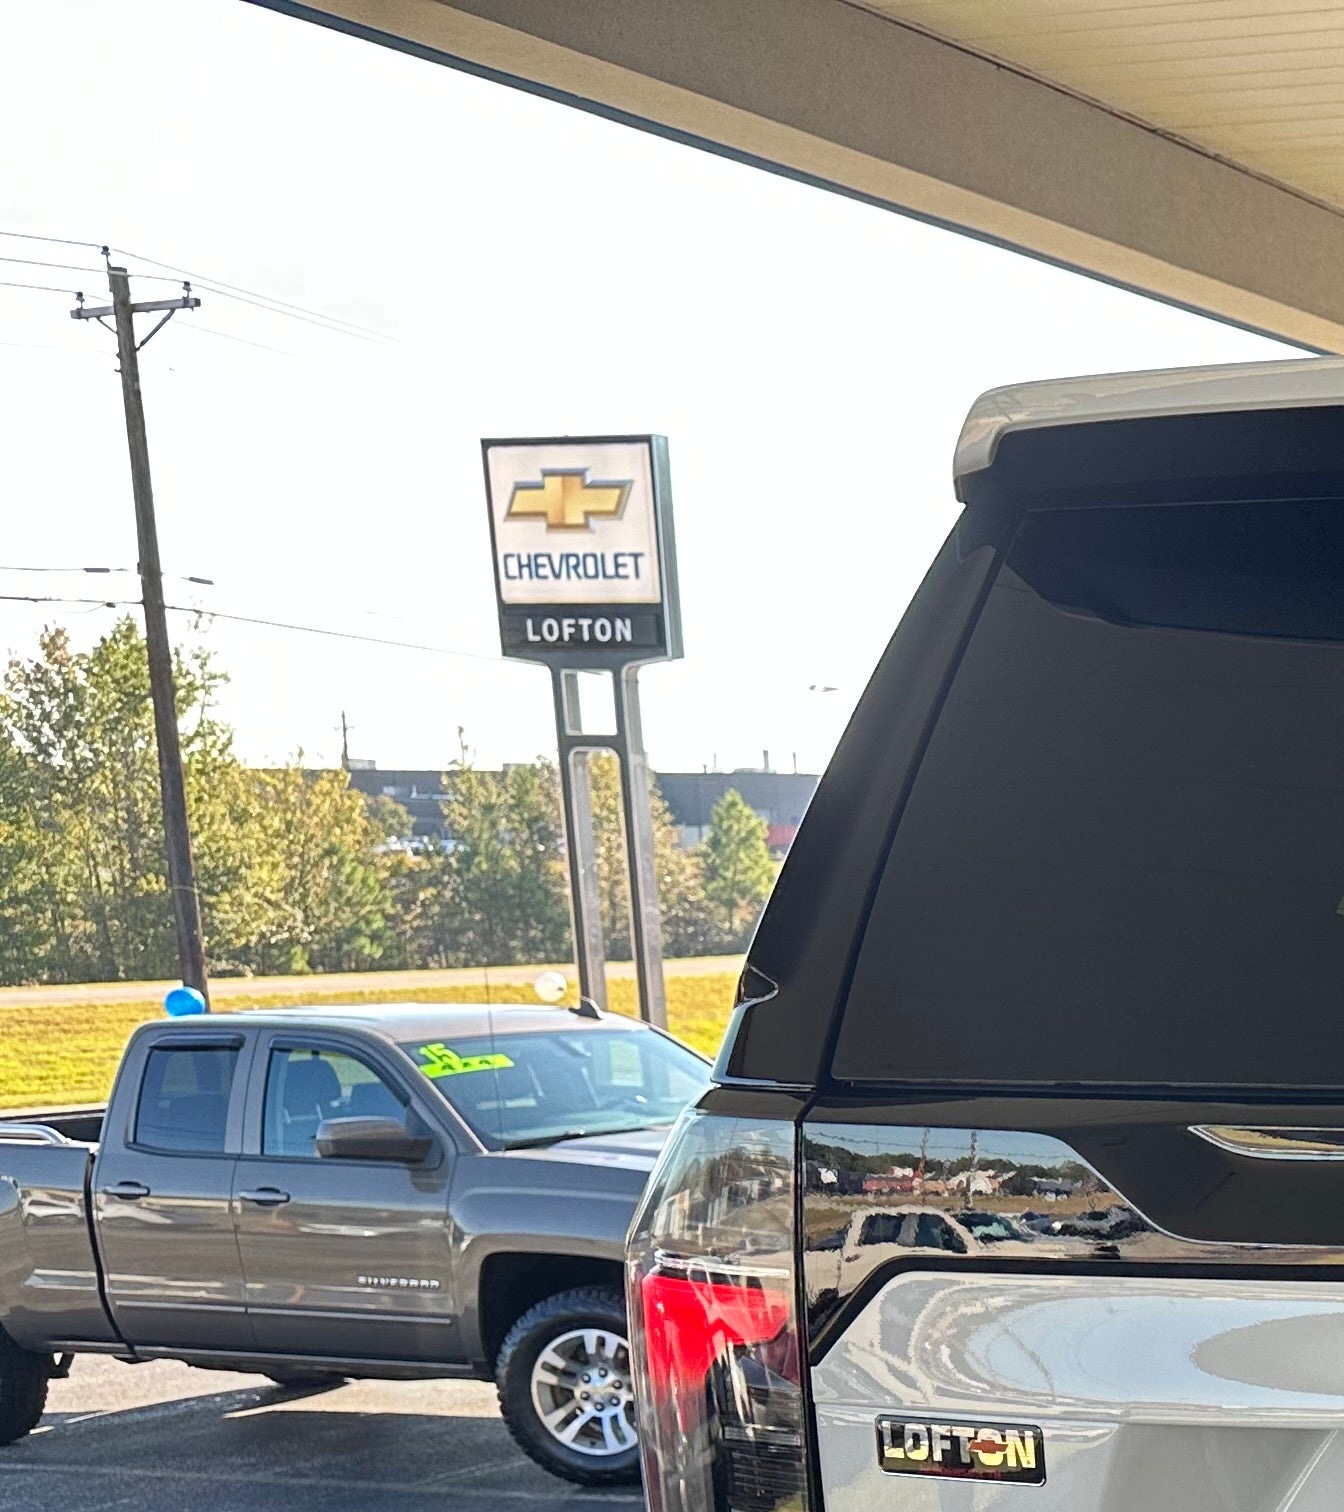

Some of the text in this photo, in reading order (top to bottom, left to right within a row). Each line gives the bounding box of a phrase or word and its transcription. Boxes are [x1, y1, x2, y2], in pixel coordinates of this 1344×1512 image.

[504, 552, 645, 581] CHEVROLET
[526, 617, 633, 642] LOFTON
[881, 1420, 1036, 1469] LOFTON
